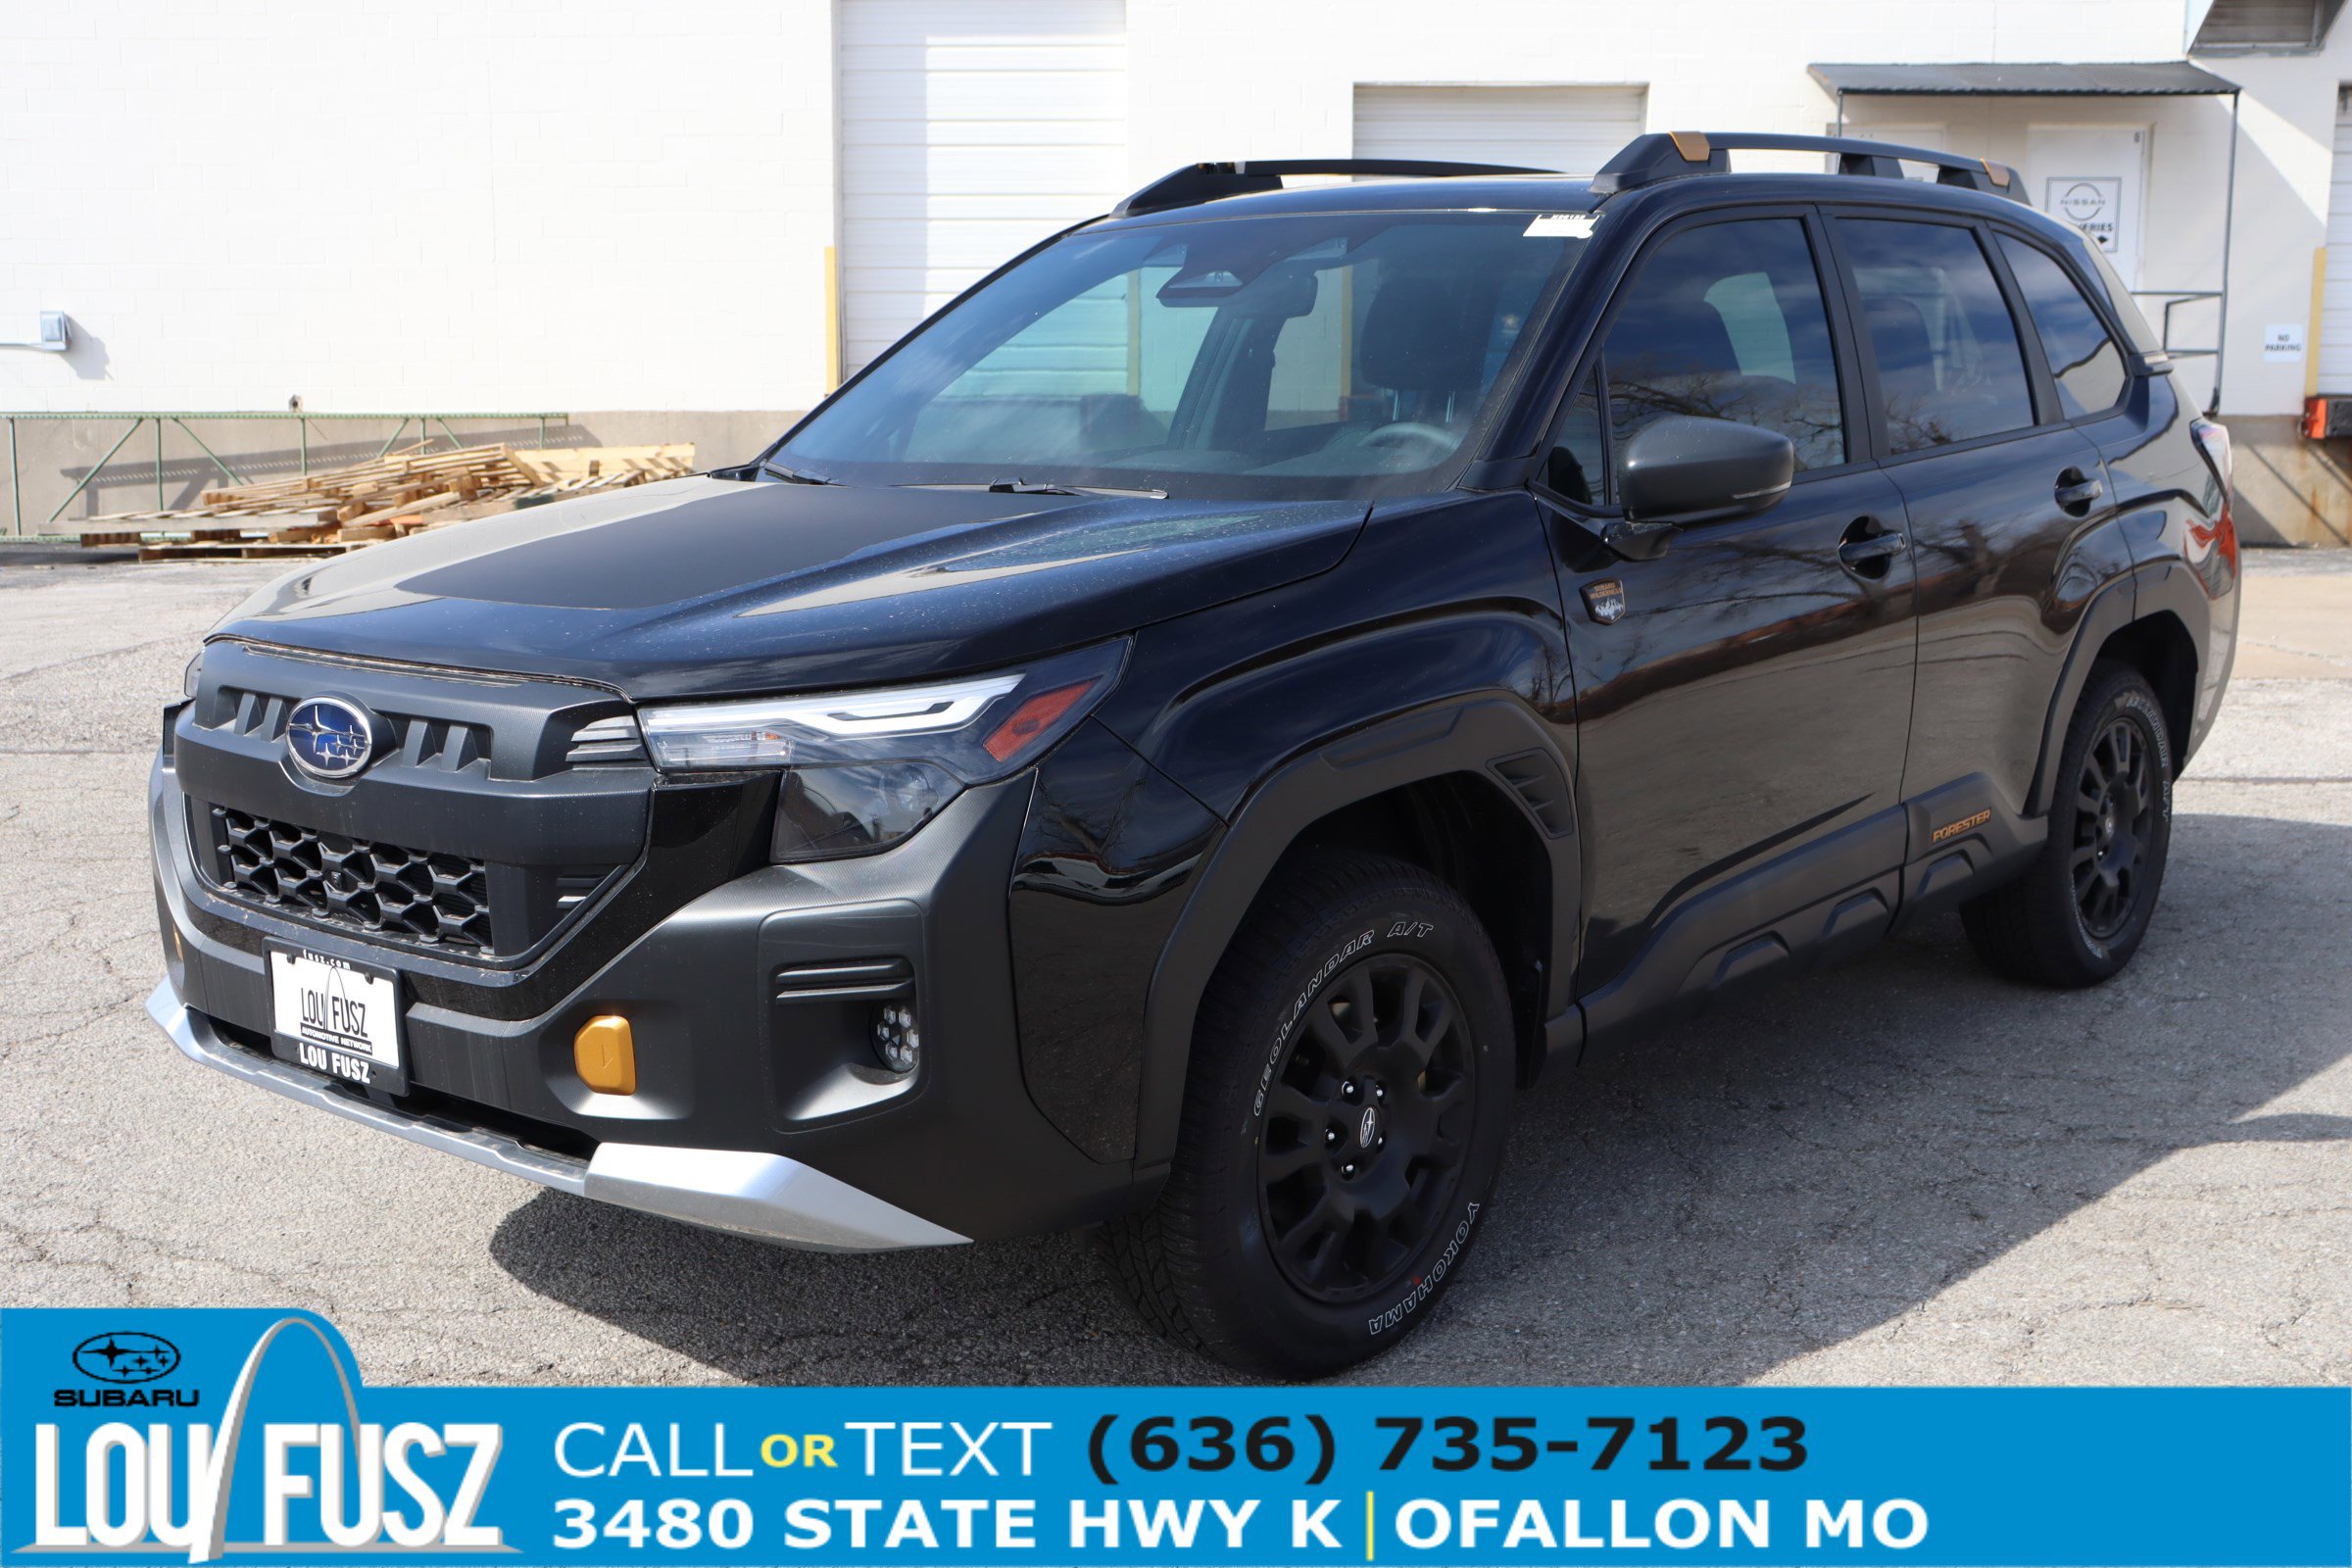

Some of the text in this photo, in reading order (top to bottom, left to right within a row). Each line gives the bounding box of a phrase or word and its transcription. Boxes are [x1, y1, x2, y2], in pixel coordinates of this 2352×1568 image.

[2079, 222, 2114, 231] ERIES
[2265, 343, 2302, 352] PARKING
[2277, 333, 2290, 342] NO
[1932, 808, 1991, 843] FORESTER
[303, 949, 351, 970] fusz.com
[301, 987, 368, 1038] LOU FUSZ
[1253, 921, 1434, 1116] GEOLANDAR A/T
[301, 1026, 372, 1054] AUTOMOTIVE NETWORK
[299, 1043, 371, 1084] LOU FUSZ
[1368, 1202, 1480, 1336] YOKOHAMA
